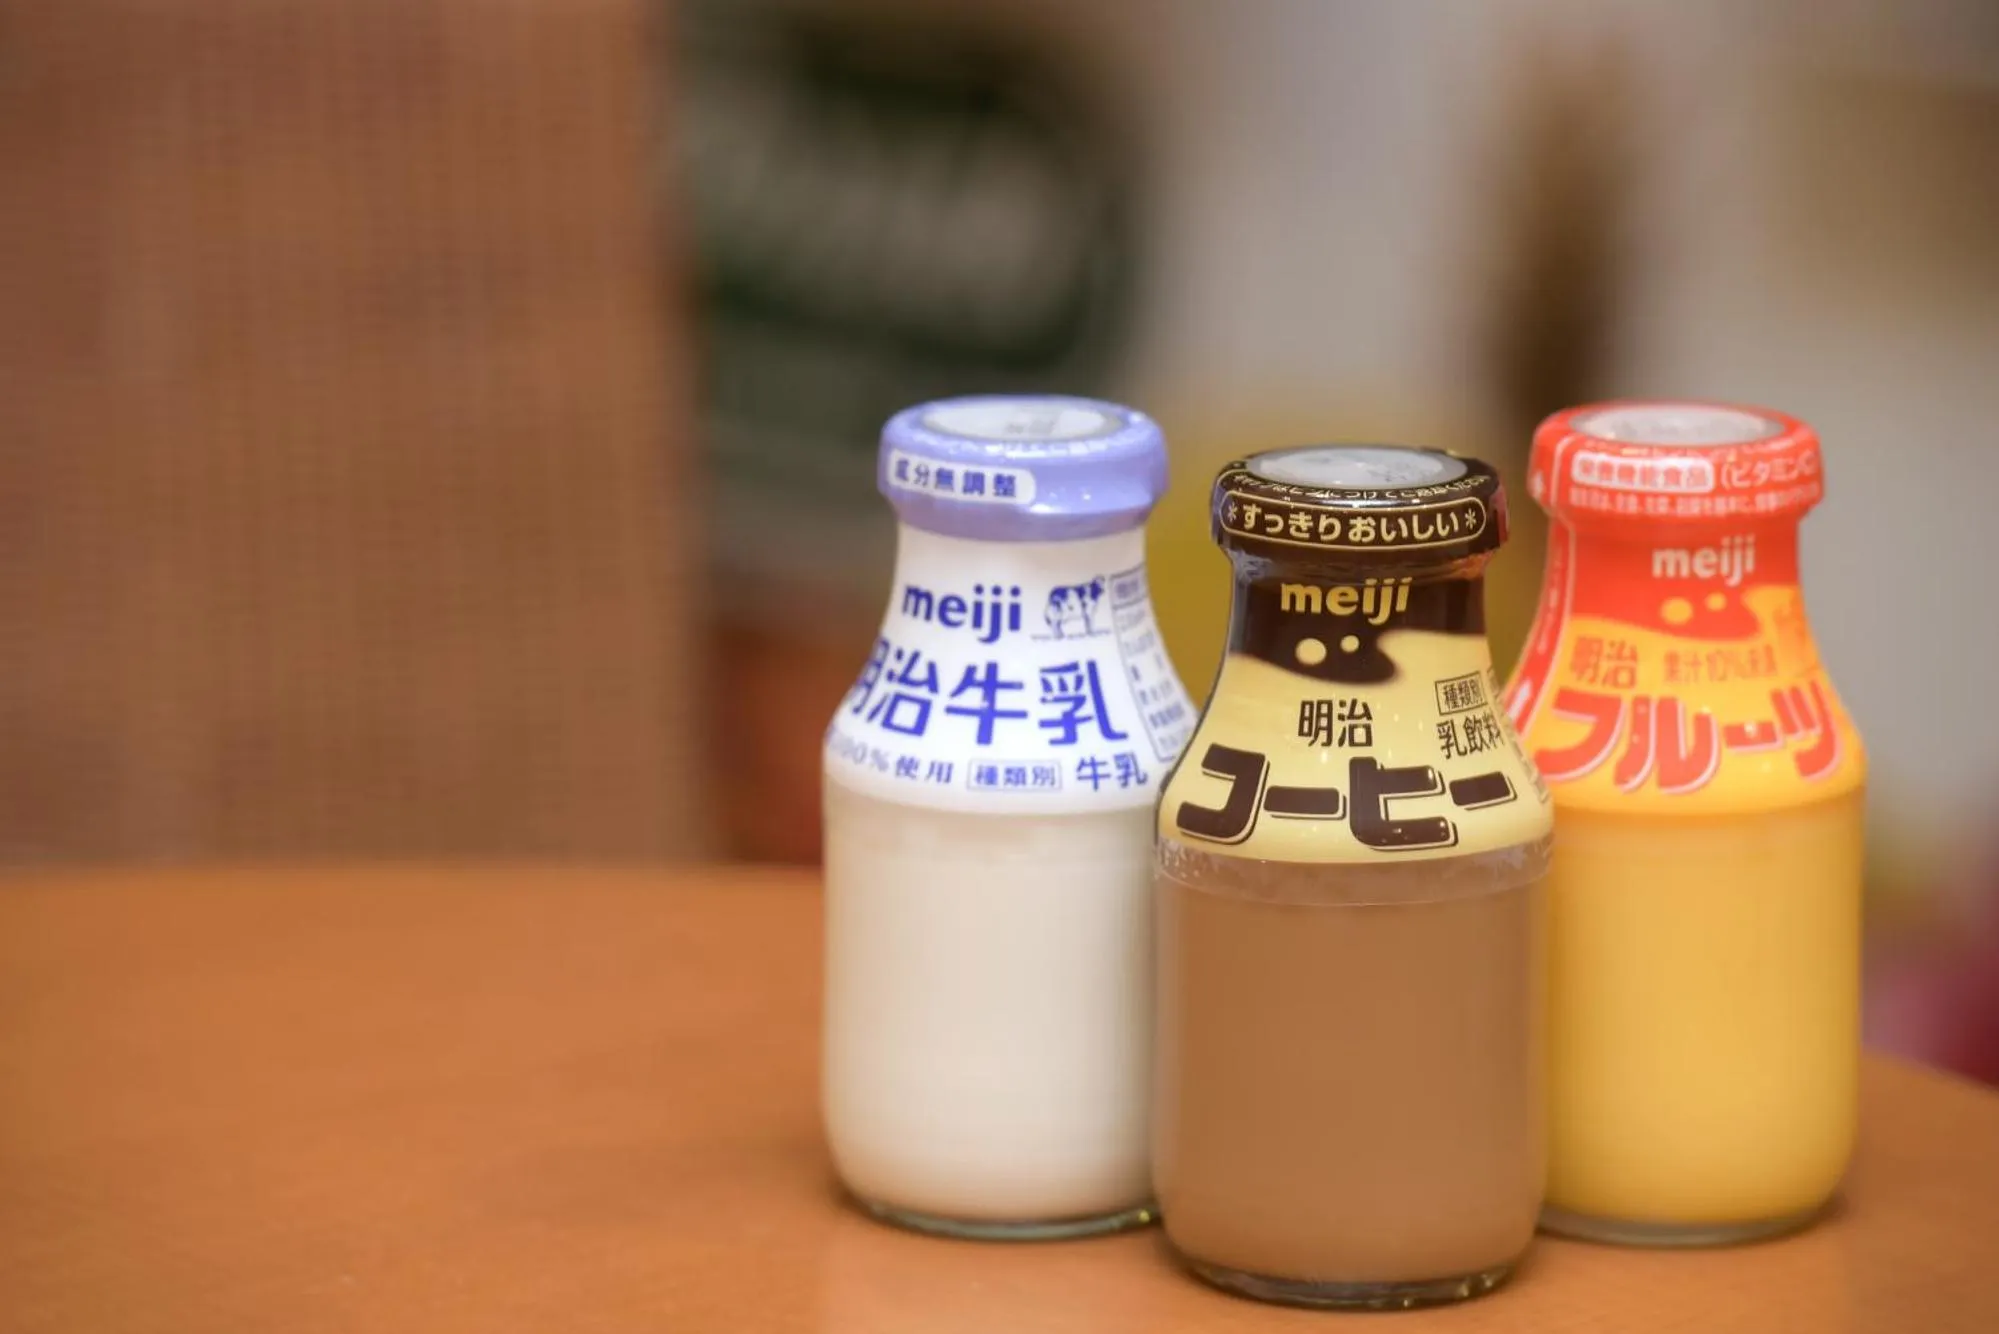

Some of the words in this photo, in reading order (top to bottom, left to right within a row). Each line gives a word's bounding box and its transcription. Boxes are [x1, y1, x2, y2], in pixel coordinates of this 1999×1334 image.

[1242, 503, 1459, 543] すっきりおいしい
[1652, 534, 1756, 588] meiji
[902, 583, 1022, 644] meiji
[1280, 577, 1413, 626] meiji
[1569, 635, 1640, 690] 明治
[1443, 678, 1484, 711] 種類別
[1297, 698, 1374, 748] 明治
[1533, 679, 1843, 794] フルーツ
[974, 763, 1057, 787] 種類別
[1075, 751, 1149, 791] 牛乳
[1175, 743, 1518, 852] コーヒー
